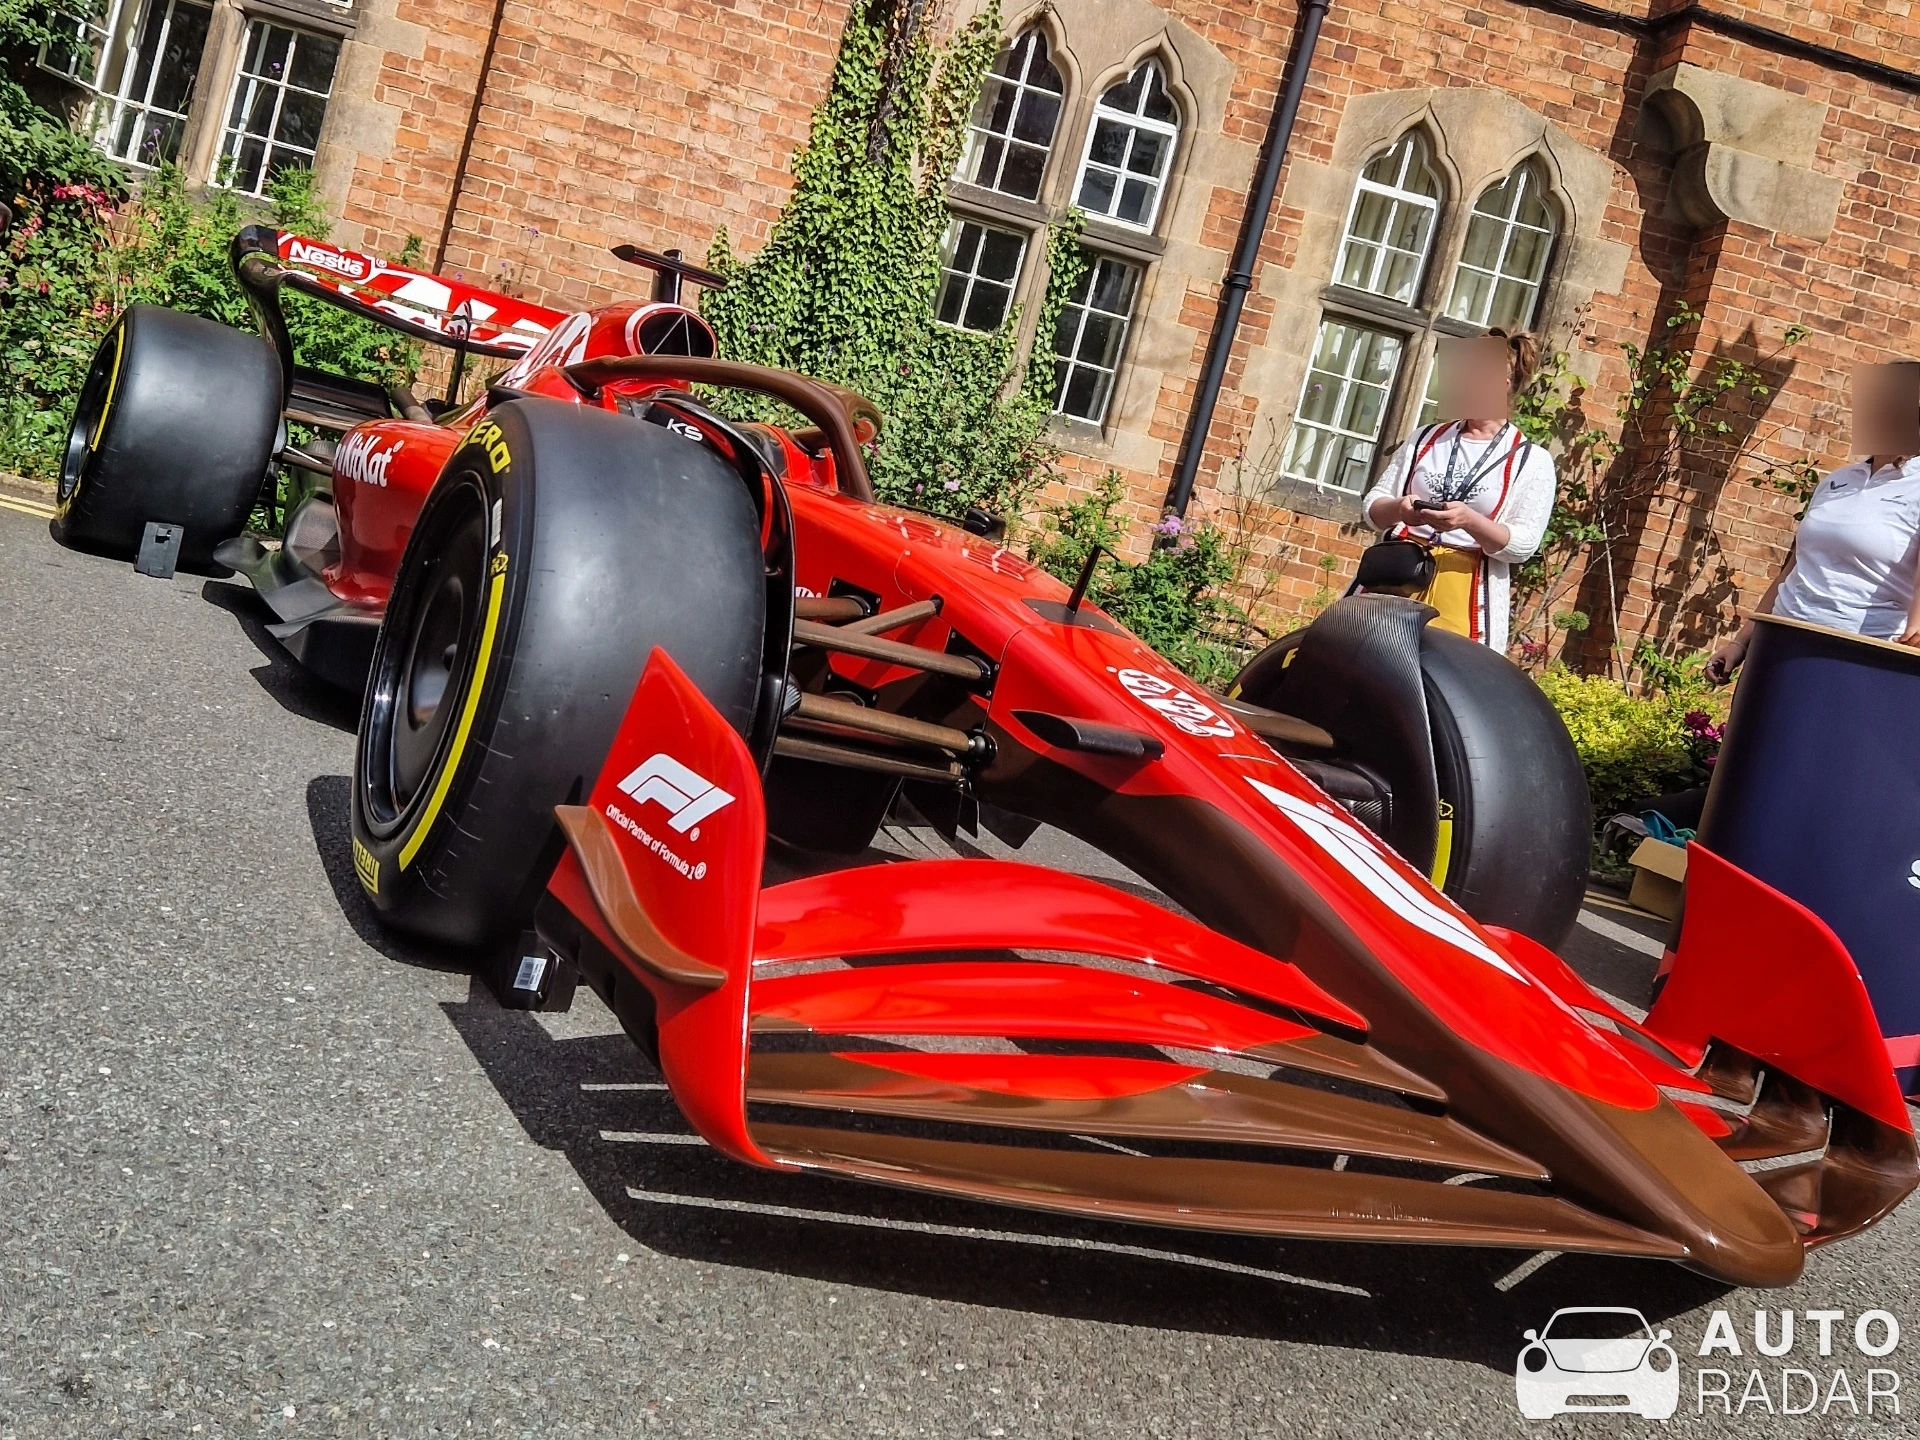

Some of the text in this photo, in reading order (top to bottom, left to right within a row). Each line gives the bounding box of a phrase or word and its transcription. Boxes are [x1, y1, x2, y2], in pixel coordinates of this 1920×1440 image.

[616, 753, 736, 834] F1
[605, 803, 631, 829] Official
[627, 819, 654, 847] Partner
[650, 839, 662, 854] of
[658, 843, 690, 877] Formula
